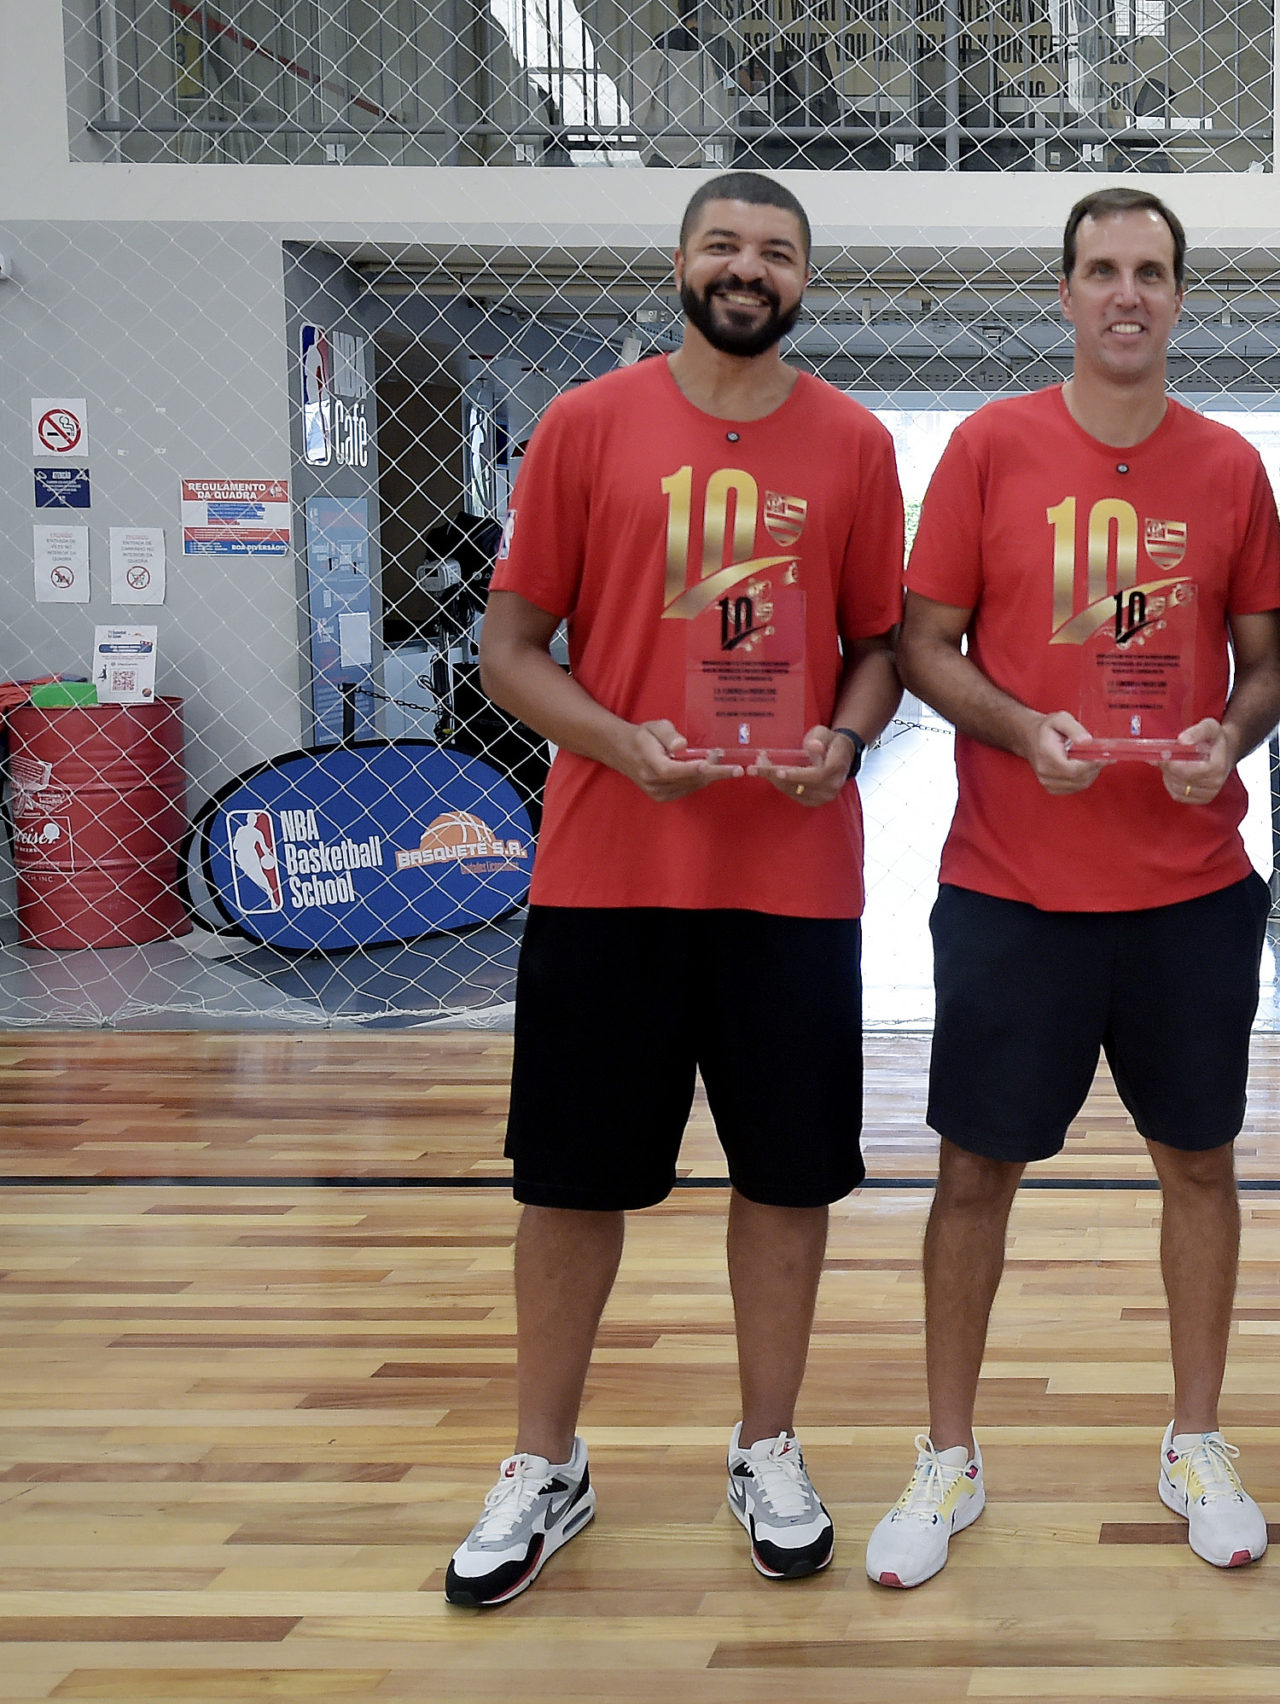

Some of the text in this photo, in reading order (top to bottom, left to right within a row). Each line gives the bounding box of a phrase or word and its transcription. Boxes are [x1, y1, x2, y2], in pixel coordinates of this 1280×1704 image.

[335, 400, 368, 467] Café
[188, 482, 267, 492] REGULAMENTO
[197, 491, 258, 500] DA QUADRA
[661, 465, 759, 609] 10
[1046, 496, 1139, 634] 10
[719, 597, 753, 650] 10
[1113, 591, 1147, 643] 10
[280, 809, 320, 842] NBA
[284, 836, 384, 876] Basketball
[397, 841, 526, 868] BASQUETE S.A.
[289, 871, 356, 909] School
